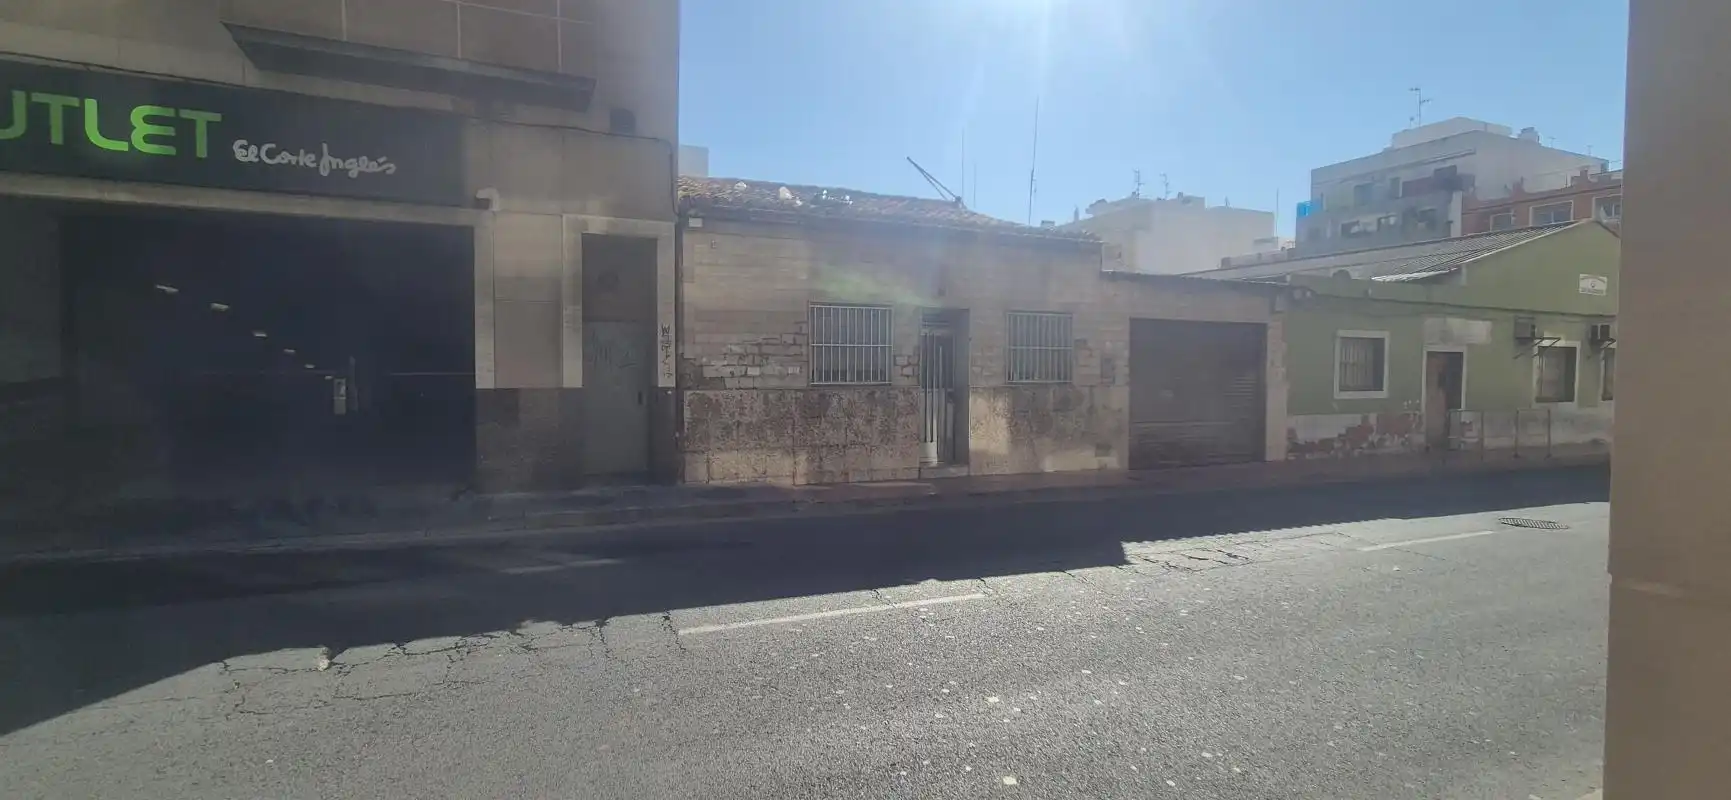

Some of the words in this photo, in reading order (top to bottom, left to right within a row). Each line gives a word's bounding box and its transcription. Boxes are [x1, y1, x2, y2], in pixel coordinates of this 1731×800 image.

[232, 139, 259, 163] El
[260, 143, 317, 168] Corte
[319, 142, 397, 178] Inglés
